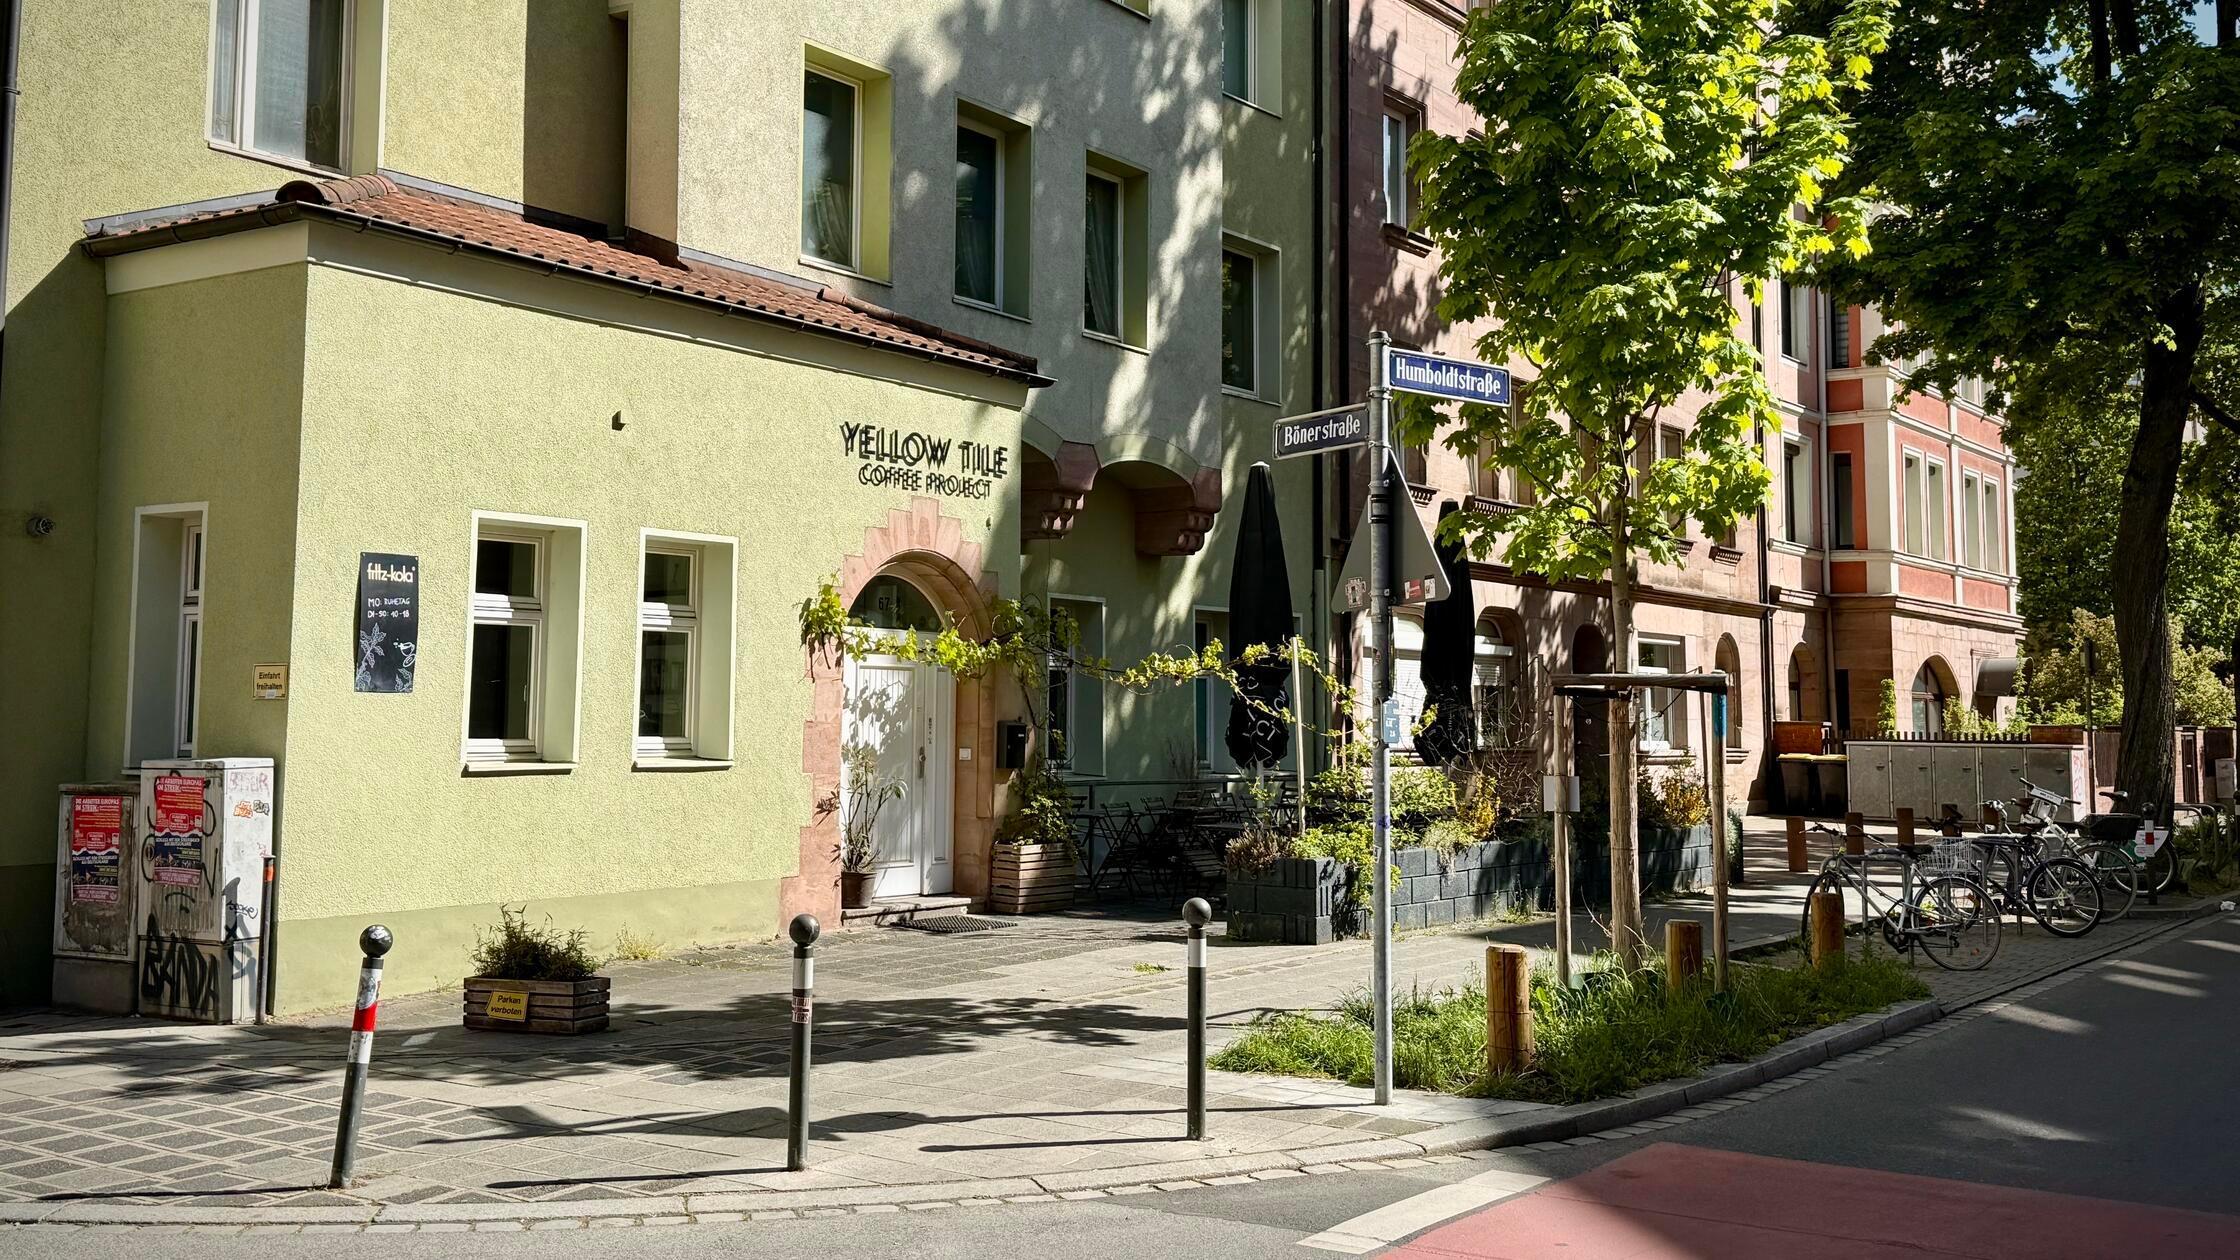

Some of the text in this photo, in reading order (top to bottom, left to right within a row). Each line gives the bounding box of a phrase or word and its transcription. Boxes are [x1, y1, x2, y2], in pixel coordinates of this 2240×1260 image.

[1395, 357, 1501, 397] Humboldtstraße
[1284, 414, 1361, 447] Bönerstraße
[840, 421, 1008, 479] YELLOW TILE
[858, 463, 992, 500] COFFEE PROJECT
[367, 562, 415, 583] fritz-kola
[878, 596, 891, 610] 67
[258, 671, 281, 680] Einfahrt
[256, 682, 283, 691] freihalten
[497, 995, 521, 1004] Parken
[491, 1006, 522, 1015] verboten
